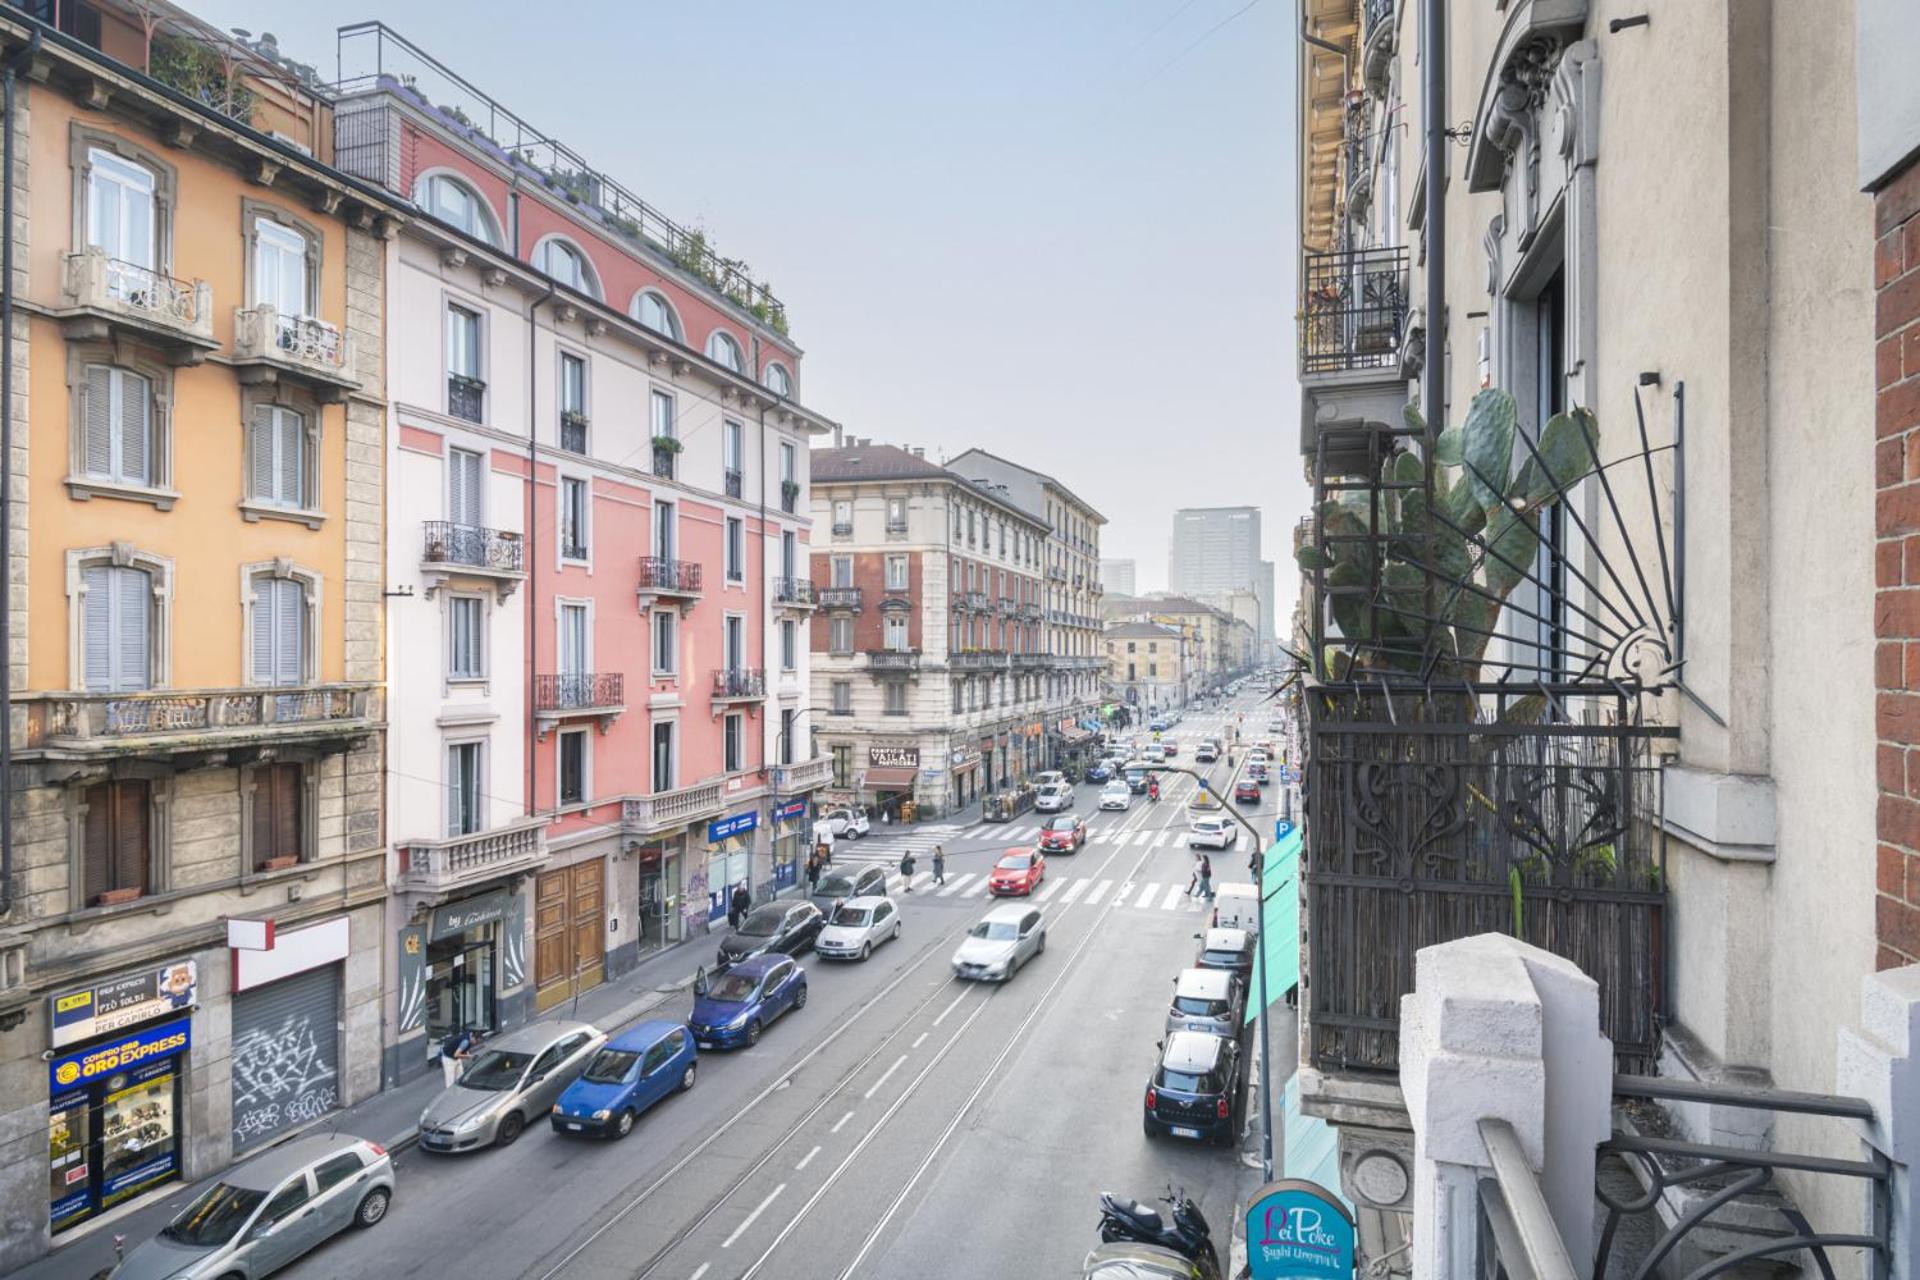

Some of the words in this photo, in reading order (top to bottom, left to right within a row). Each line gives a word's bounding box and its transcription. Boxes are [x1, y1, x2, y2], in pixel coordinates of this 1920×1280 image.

[872, 753, 917, 762] VAILATI
[1280, 822, 1289, 834] P
[95, 1022, 115, 1034] PER
[117, 1008, 161, 1029] CAPIRLO
[83, 1046, 120, 1064] COMPRO
[83, 1056, 119, 1077] ORO
[120, 1033, 187, 1065] EXPRESS
[1289, 1207, 1336, 1246] Poke
